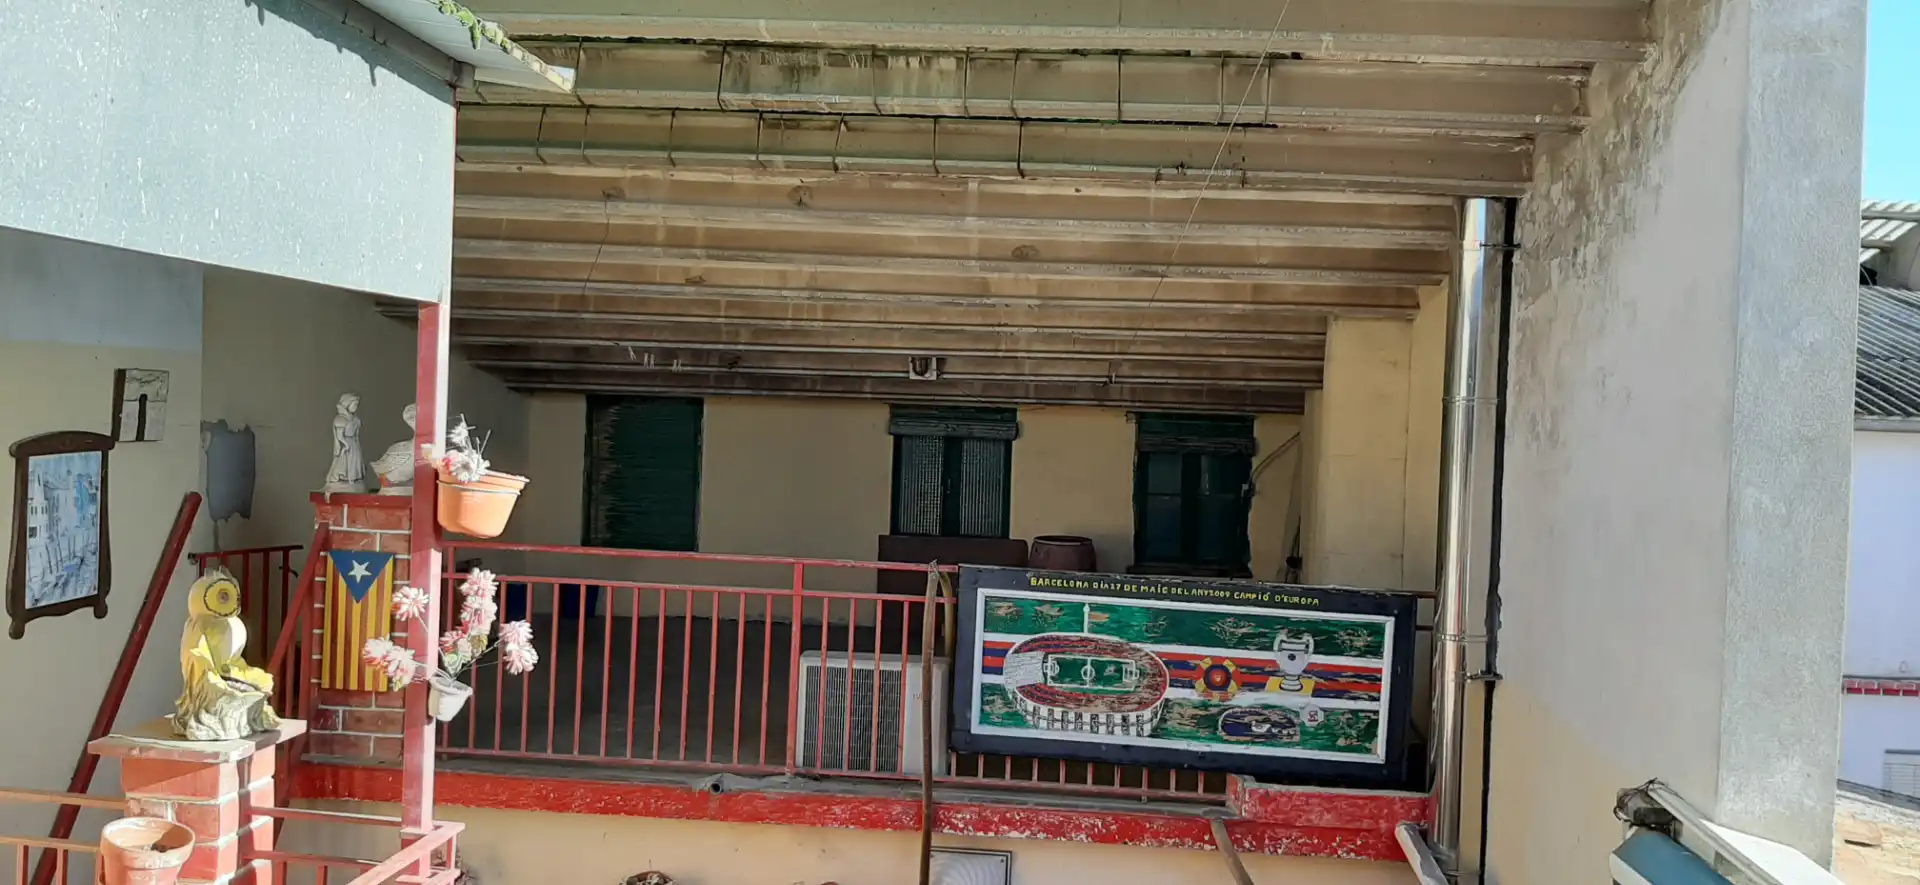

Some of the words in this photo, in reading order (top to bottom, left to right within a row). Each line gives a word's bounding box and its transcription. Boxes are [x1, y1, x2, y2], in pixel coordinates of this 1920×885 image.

[1030, 577, 1089, 589] BARCELONA
[1124, 584, 1137, 593] DE
[1171, 587, 1189, 596] DEL
[1275, 594, 1320, 607] D'EUROPA
